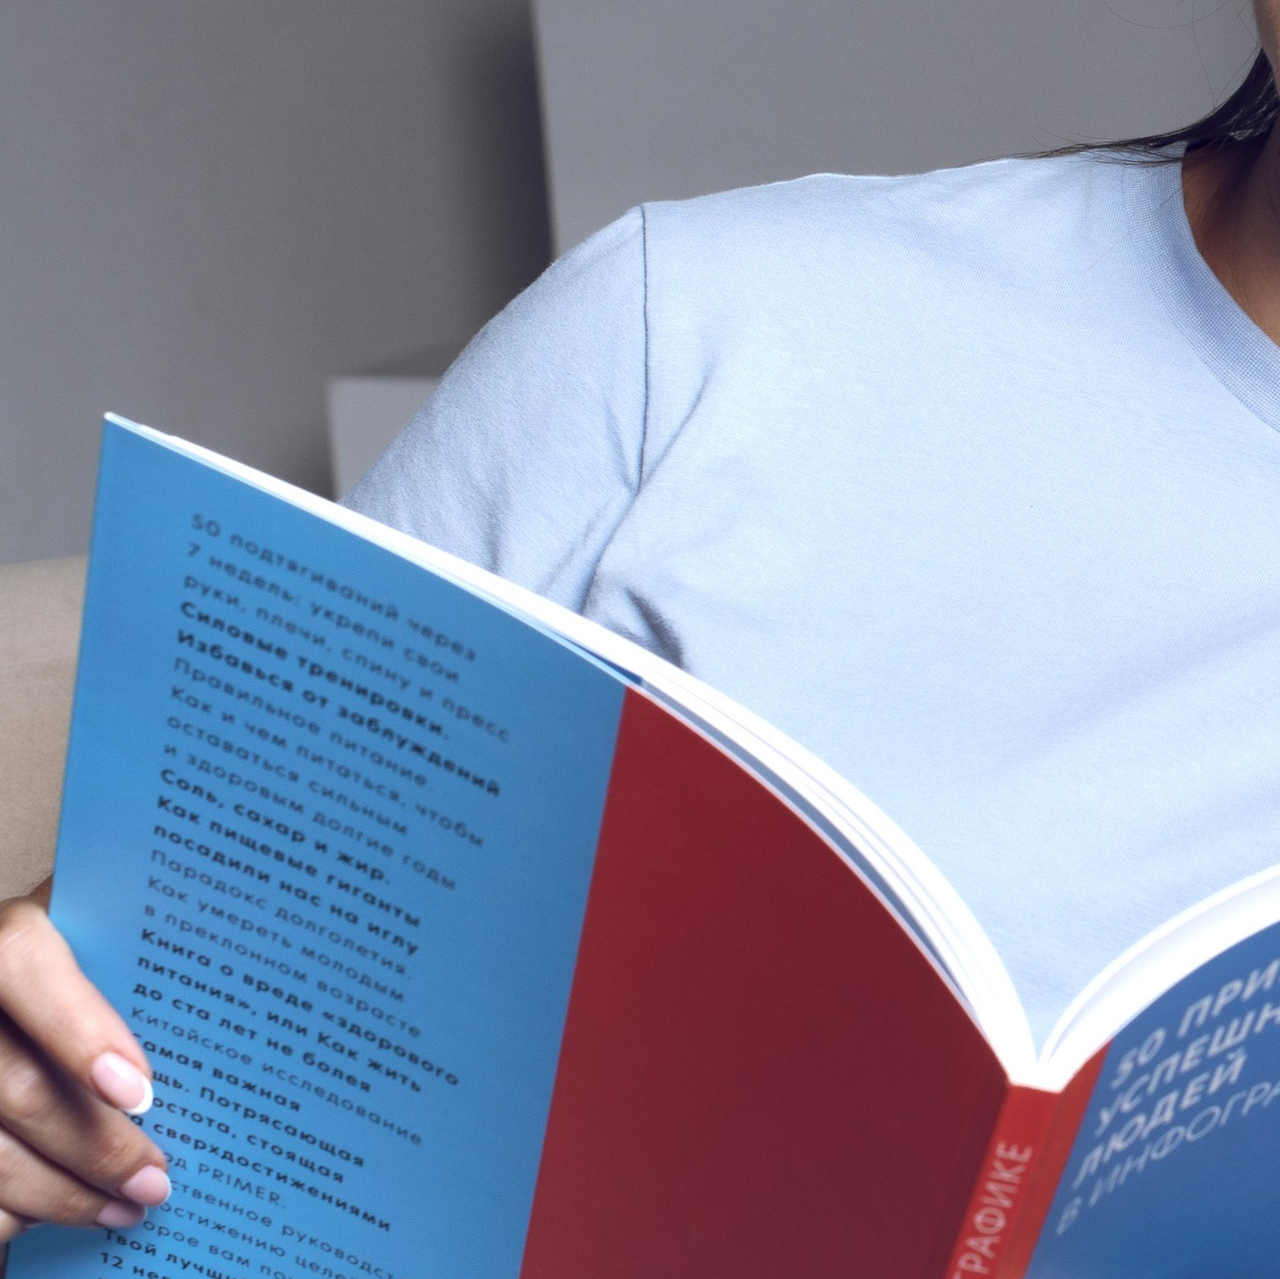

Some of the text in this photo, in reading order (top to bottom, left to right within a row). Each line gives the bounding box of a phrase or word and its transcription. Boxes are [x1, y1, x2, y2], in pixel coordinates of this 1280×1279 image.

[191, 512, 476, 662] 50 подтягиваний через
[309, 601, 395, 650] укрепи
[402, 646, 459, 683] свои
[176, 628, 500, 797] Избавься от заблуждений
[179, 600, 449, 740] Силовые тренировки.
[170, 684, 212, 715] Как
[243, 720, 287, 749] чем
[414, 802, 484, 847] чтобы
[185, 752, 304, 815] здоровым
[310, 810, 394, 858] долгие
[401, 853, 456, 890] годы
[150, 848, 267, 910] Парадокс
[156, 794, 420, 928] Как пищевые гиганты
[159, 767, 224, 809] Соль,
[232, 802, 306, 843] сахар
[336, 850, 388, 883] жир.
[146, 875, 404, 1003] Как умереть молодым
[153, 824, 418, 956] посадили нас на иглу
[136, 956, 421, 1092] питания», или Как жить
[140, 927, 211, 968] Книга
[241, 972, 313, 1012] вреде
[321, 1010, 458, 1086] «здорового
[164, 912, 307, 983] преклонном
[316, 979, 421, 1039] возрасте
[130, 1005, 422, 1146] Китайское исследование
[131, 982, 371, 1093] до ста лет не болея
[133, 1032, 204, 1072] амая
[211, 1067, 300, 1112] важная
[1111, 1027, 1167, 1091] 50
[151, 1095, 344, 1184] остота, стоящая
[199, 1085, 364, 1168] Потрясающая
[1071, 1047, 1248, 1192] ЛЮДЕЙ
[152, 1122, 390, 1231] сверхдостижениями
[159, 1196, 286, 1257] остижению
[170, 1175, 273, 1228] ственное
[1054, 1197, 1082, 1236] В
[100, 1251, 123, 1269] 12
[104, 1227, 157, 1257] Твой
[142, 1220, 200, 1248] орое
[207, 1243, 250, 1268] вам
